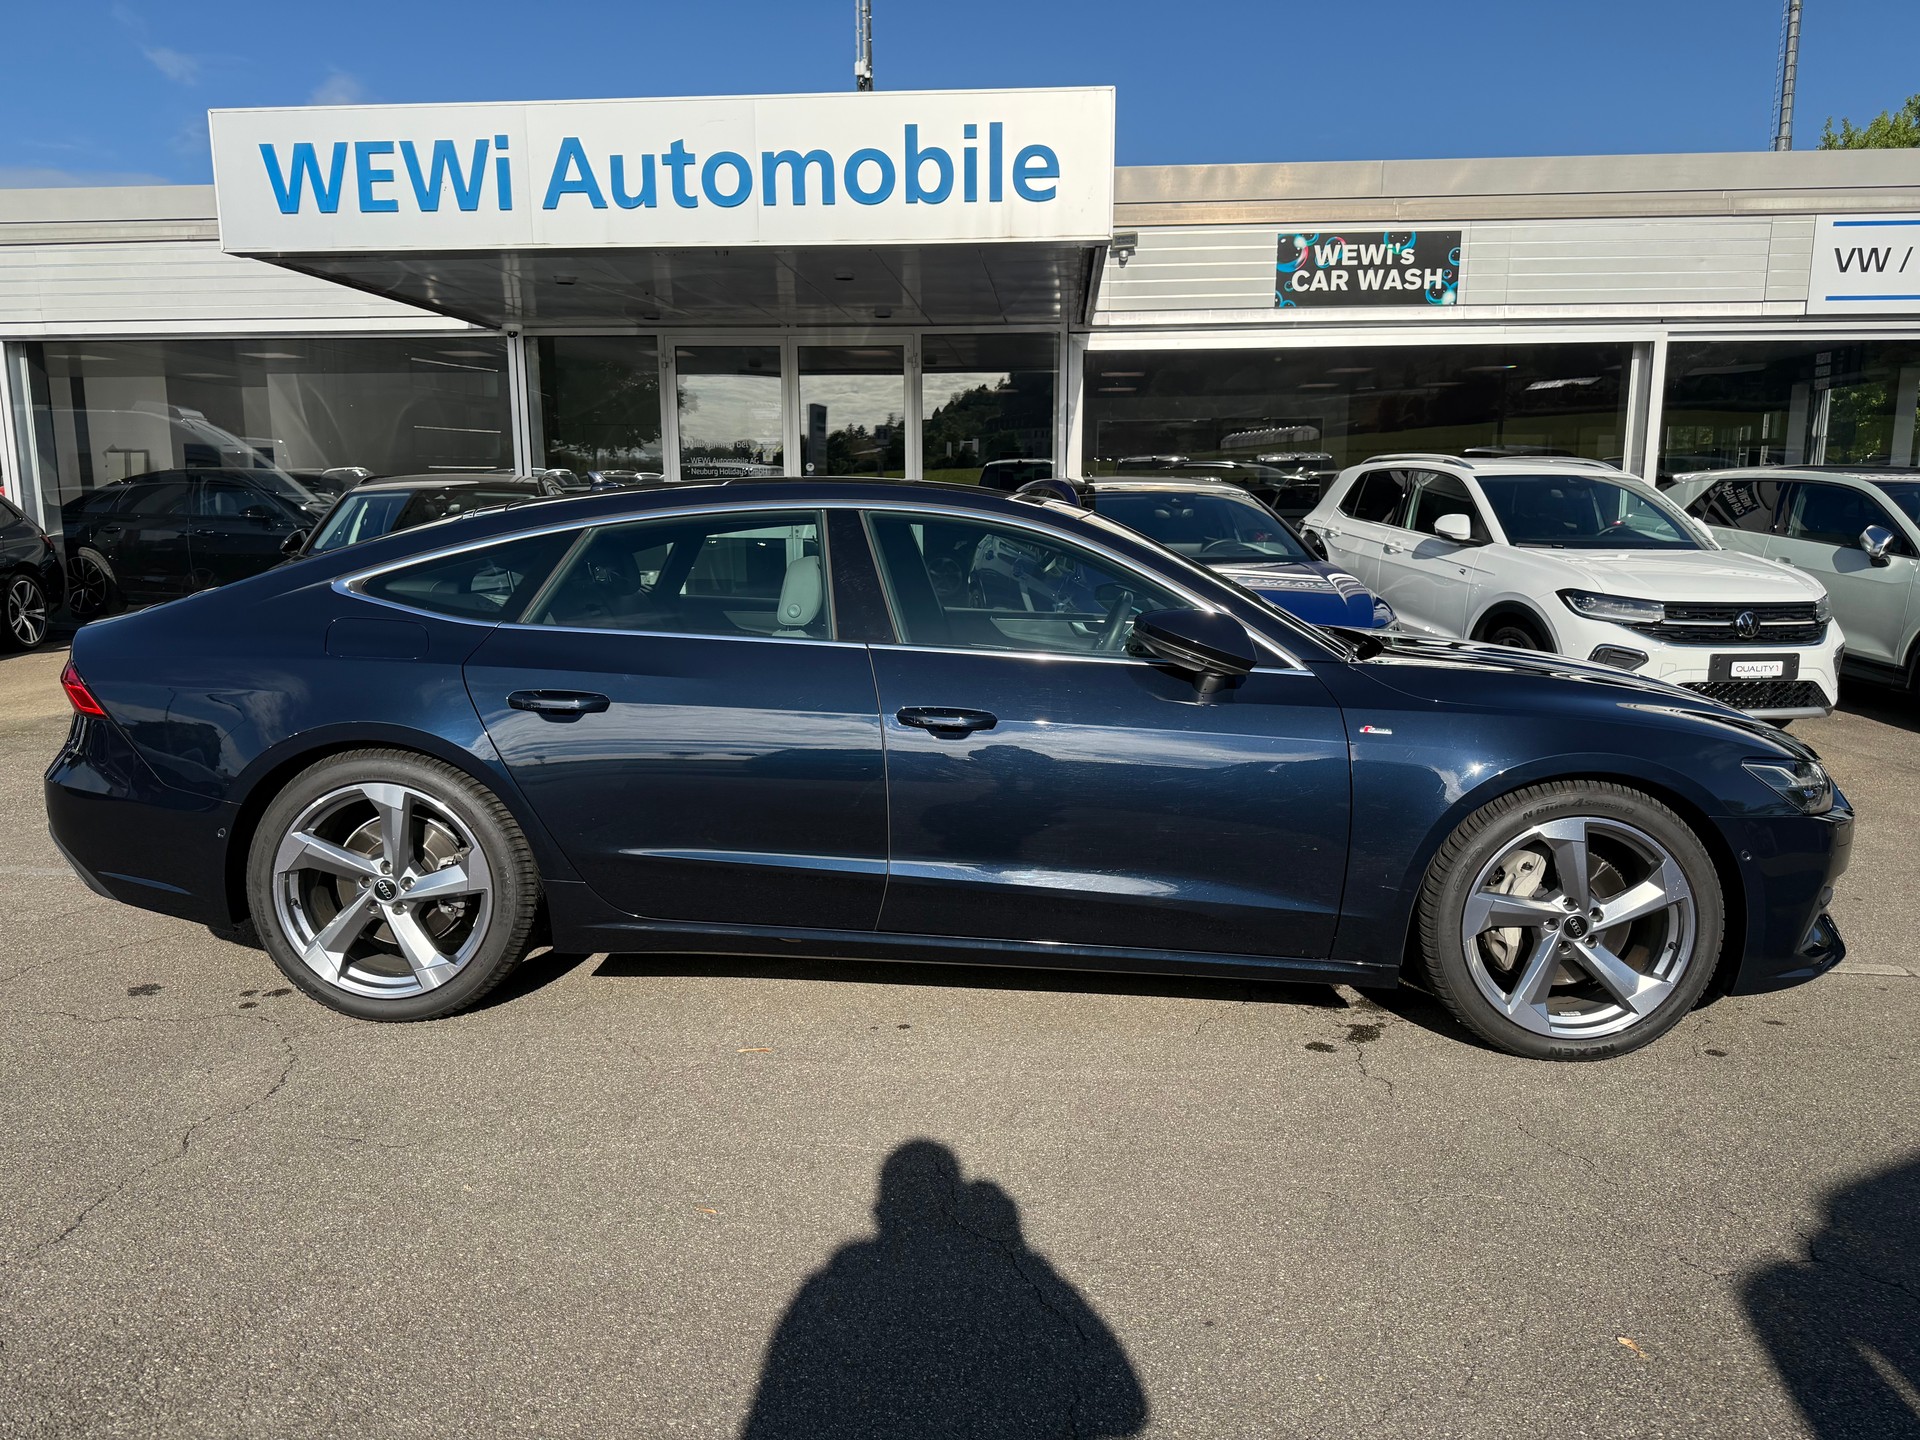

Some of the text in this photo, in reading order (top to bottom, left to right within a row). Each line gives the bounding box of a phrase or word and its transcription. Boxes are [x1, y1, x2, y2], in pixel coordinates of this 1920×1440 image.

[258, 122, 1060, 215] WEWi Automobile
[1313, 242, 1416, 267] WEWi's
[1833, 246, 1914, 273] VW /
[1291, 268, 1443, 292] CAR WASH
[691, 468, 768, 476] Neuburg Holidays GmbH
[1735, 664, 1780, 673] QUALITY 1
[1549, 1043, 1616, 1057] NEXEN
